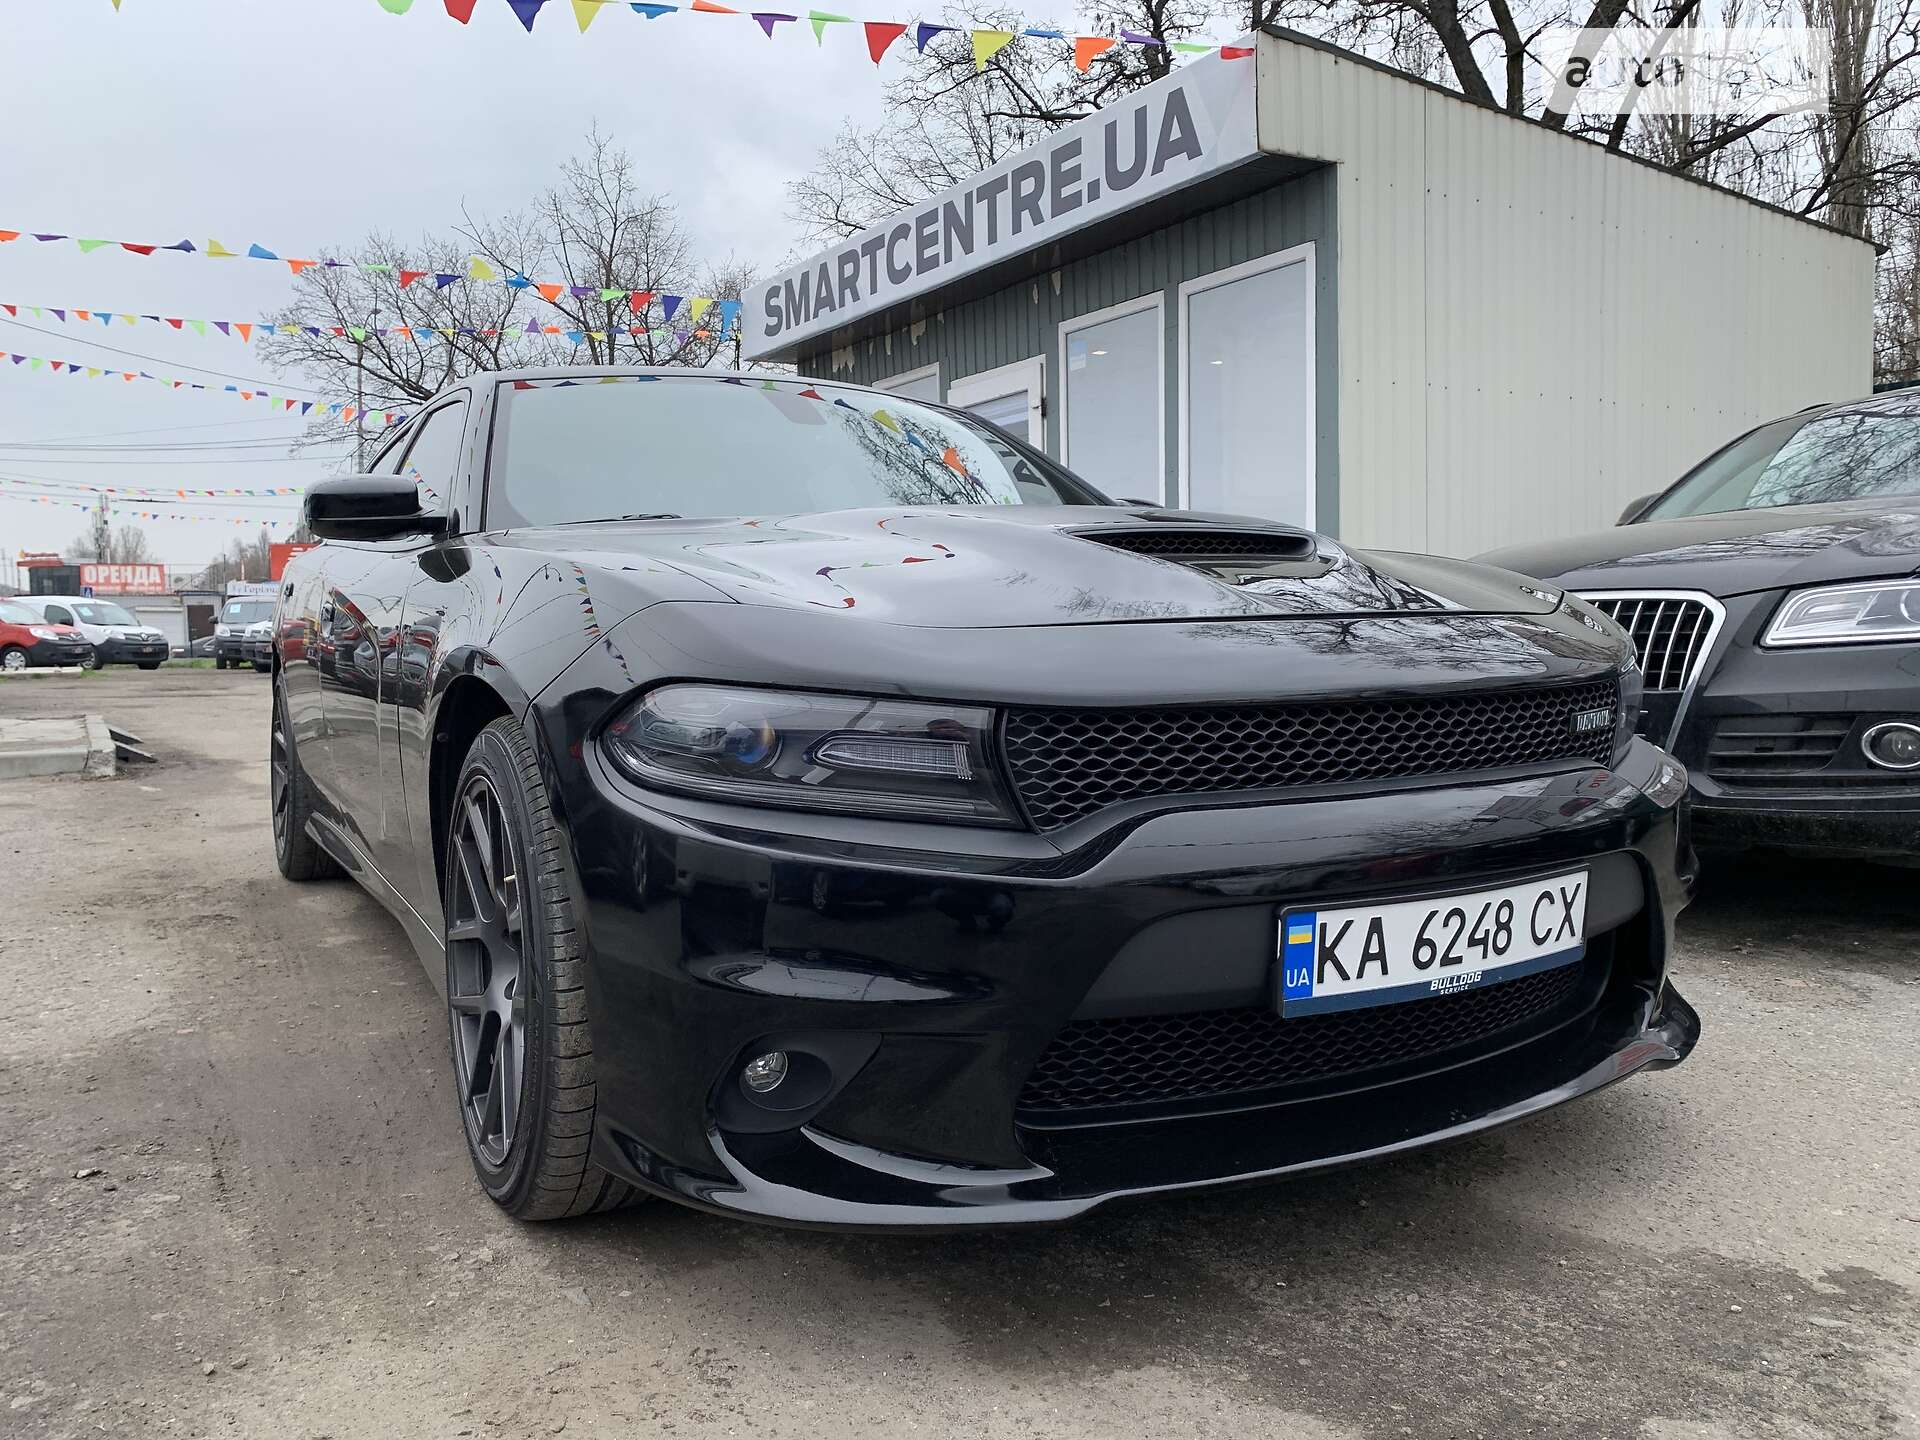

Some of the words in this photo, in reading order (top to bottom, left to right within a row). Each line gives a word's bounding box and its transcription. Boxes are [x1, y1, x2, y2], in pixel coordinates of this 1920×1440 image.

[763, 86, 1203, 338] SMARTCENTRE.UA
[84, 565, 161, 585] ОРЕНДА
[1316, 916, 1389, 984] KA
[1412, 898, 1514, 970] 6248
[1530, 882, 1582, 946] CX
[1286, 967, 1310, 987] UA
[1430, 971, 1482, 991] BULLDOG
[1440, 984, 1469, 995] SERVICE
